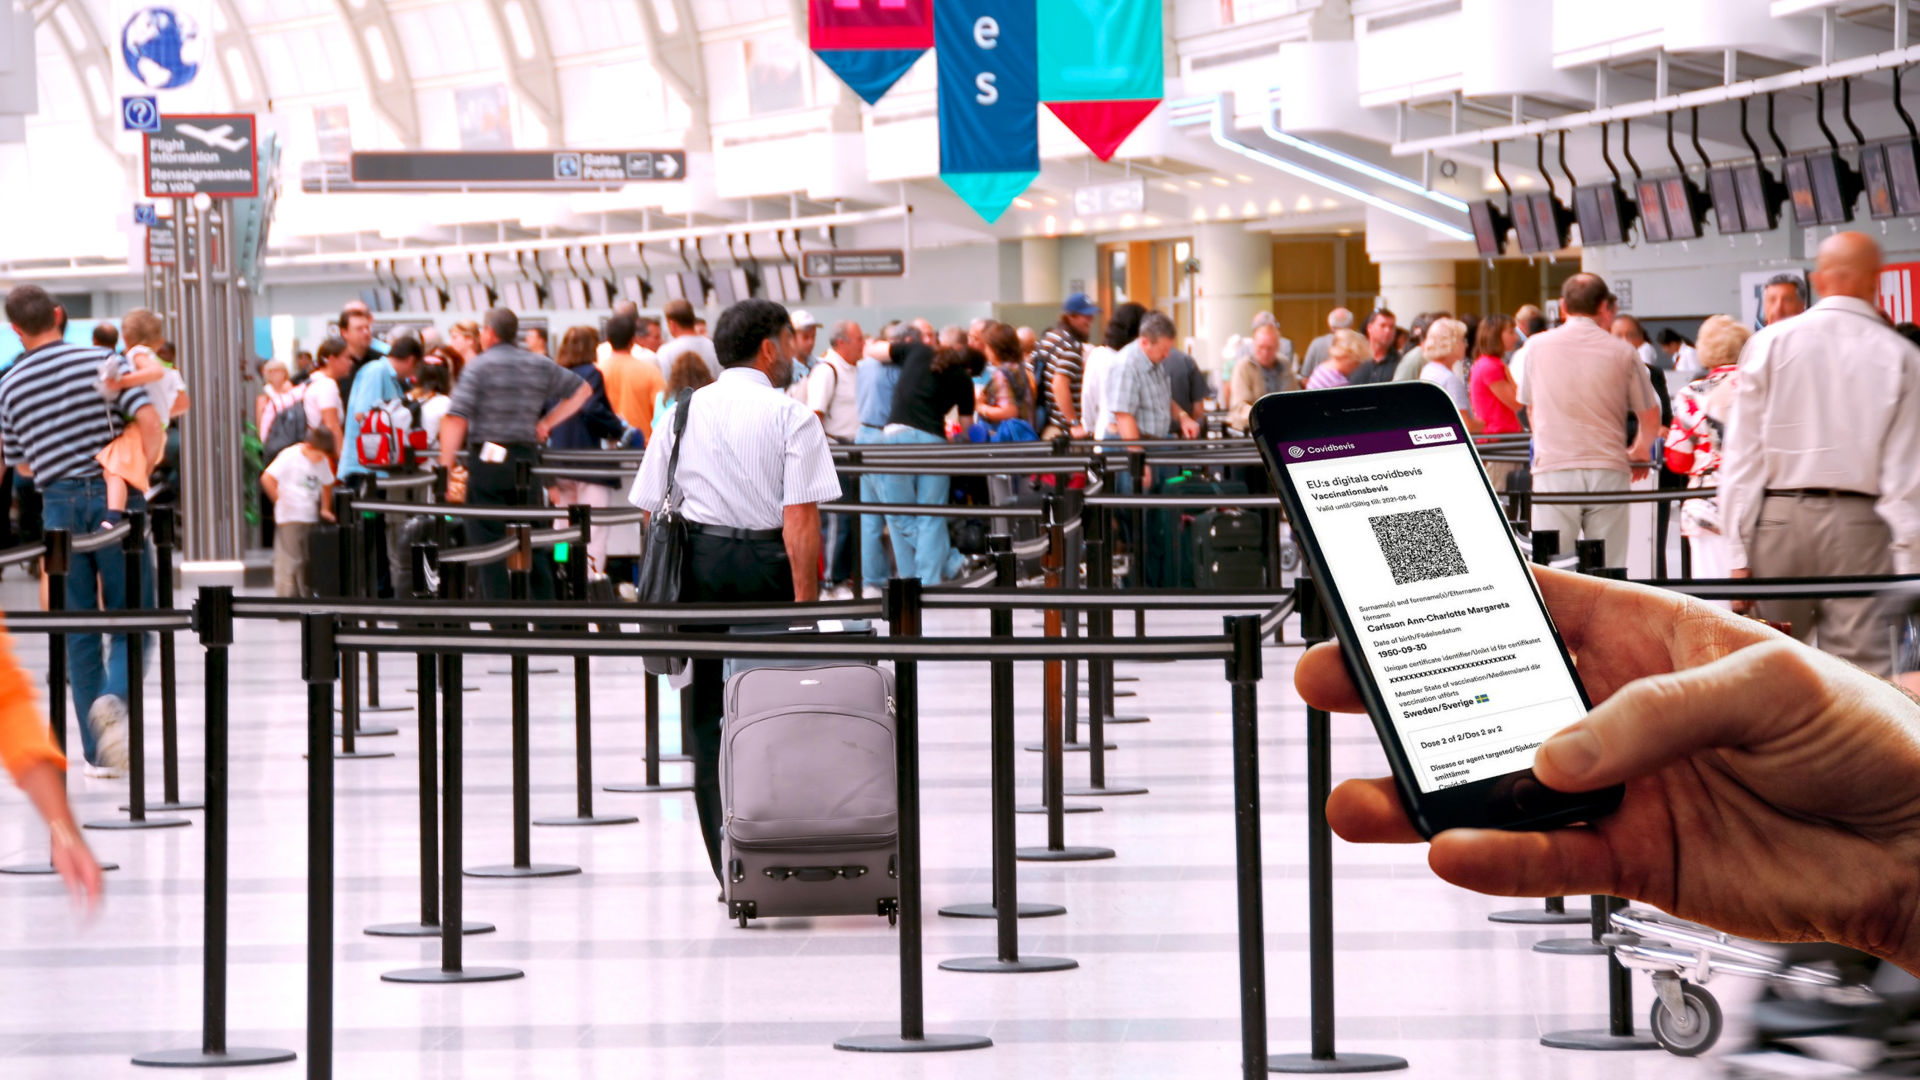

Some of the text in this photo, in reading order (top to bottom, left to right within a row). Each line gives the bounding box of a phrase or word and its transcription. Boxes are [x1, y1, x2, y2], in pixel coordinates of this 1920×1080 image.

[150, 138, 186, 153] Flight
[150, 151, 220, 164] Information
[151, 168, 251, 183] Renseignements
[151, 181, 196, 193] de vols
[1307, 442, 1355, 454] Covidbevis
[1306, 467, 1423, 489] EU:s digitala covidbevis
[1311, 484, 1389, 501] Vaccinationsbevis
[1316, 505, 1334, 513] Valid
[1381, 494, 1416, 504] 2021-08-01
[1359, 601, 1396, 612] Surname(s)
[1397, 598, 1409, 606] and
[1482, 584, 1495, 592] och
[1367, 602, 1510, 633] Carlsson Ann-Charlotte Margareta
[1373, 627, 1462, 648] Date of birth/Födelsedatum
[1377, 643, 1427, 658] 1950-09-30
[1383, 664, 1408, 672] Unique
[1409, 657, 1442, 668] certificate
[1394, 688, 1423, 698] Member
[1423, 684, 1442, 692] State
[1442, 681, 1450, 689] of
[1399, 695, 1437, 707] vaccination
[1403, 699, 1474, 719] Sweden/Sverige
[1420, 740, 1441, 749] Dose
[1441, 737, 1447, 745] 2
[1448, 735, 1456, 743] of
[1456, 731, 1481, 741] 2/Dos
[1480, 729, 1487, 737] 2
[1496, 725, 1503, 733] 2
[1430, 761, 1457, 772] Disease
[1457, 759, 1465, 767] or
[1466, 754, 1485, 764] agent
[1434, 769, 1470, 781] smittämne
